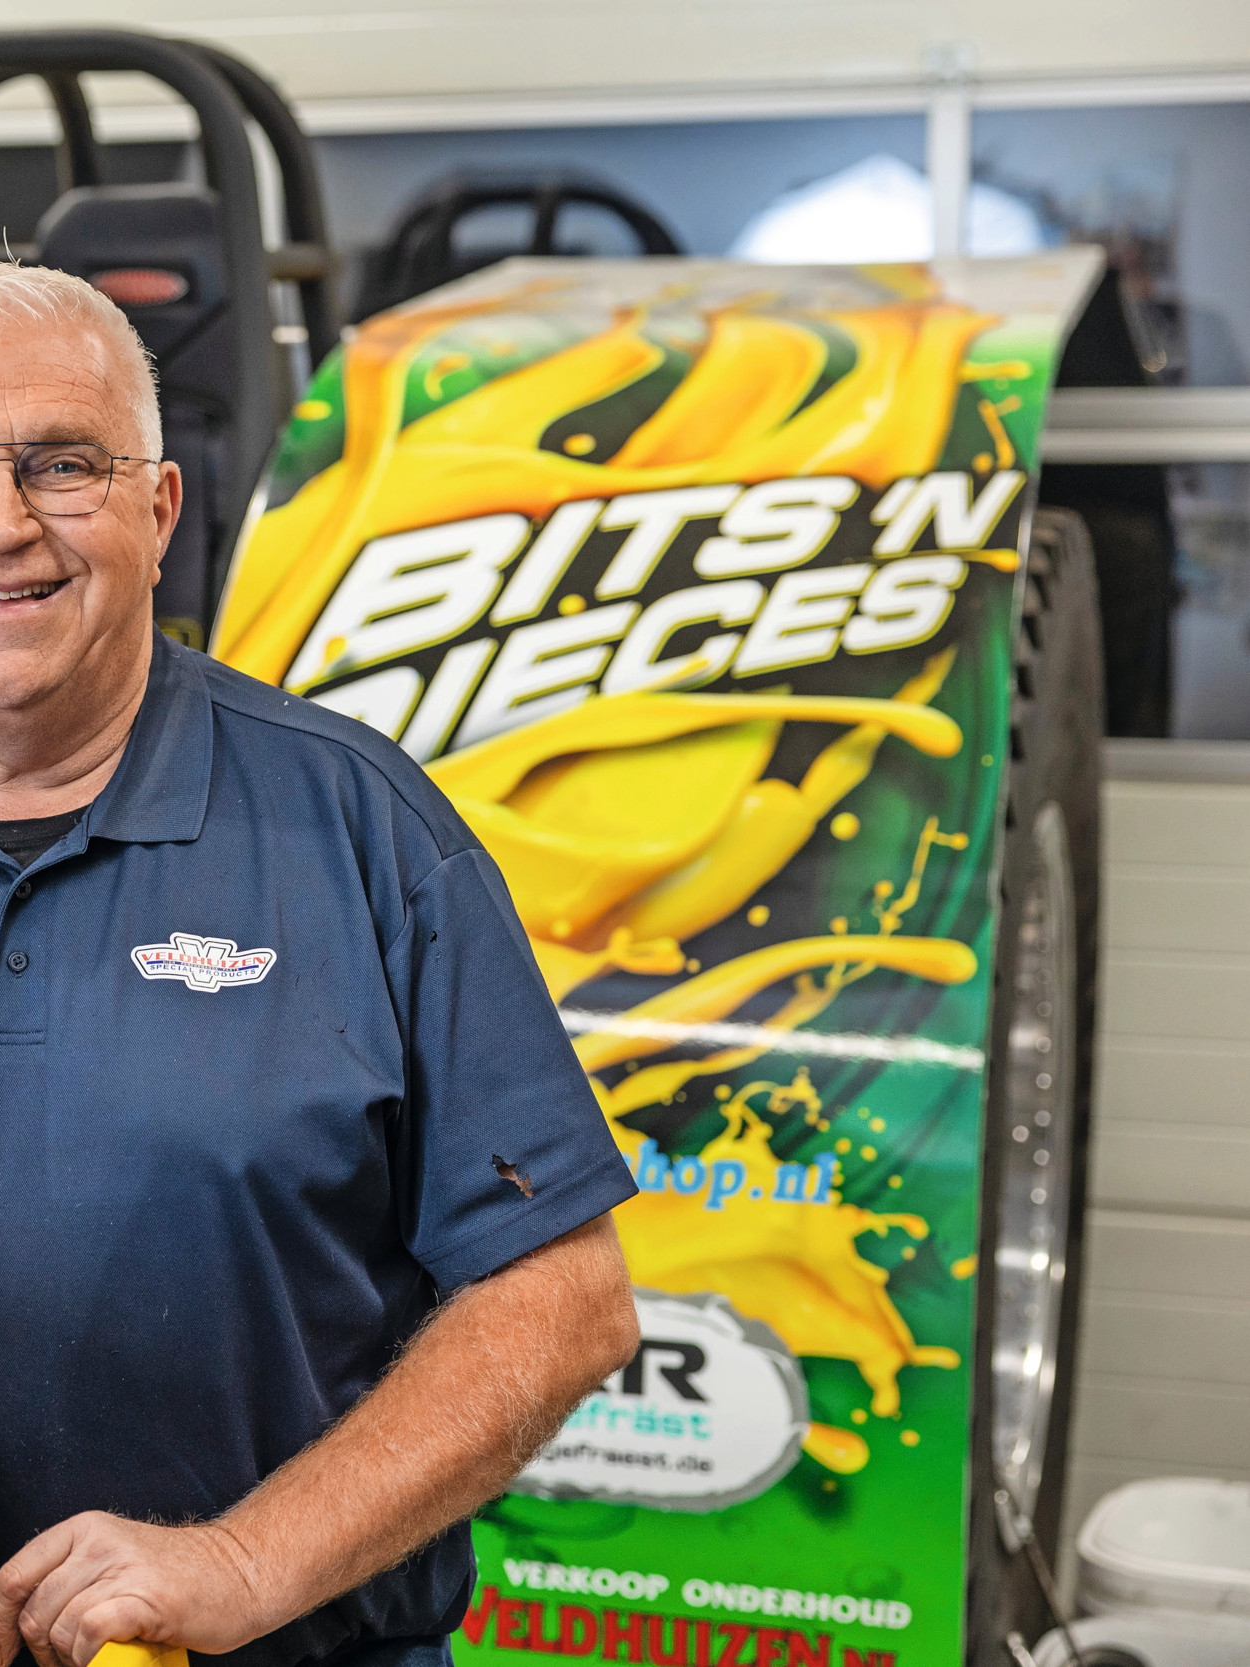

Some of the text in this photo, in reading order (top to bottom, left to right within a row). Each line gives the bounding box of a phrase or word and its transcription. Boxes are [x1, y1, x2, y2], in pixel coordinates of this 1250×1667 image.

[141, 952, 267, 968] VELDHUIZEN
[150, 963, 194, 973] SPECIAL
[198, 968, 256, 978] PRODUCTS
[623, 1138, 838, 1211] hop.nl
[504, 1559, 669, 1601] VERKOOP
[681, 1578, 913, 1630] ONDERHOUD
